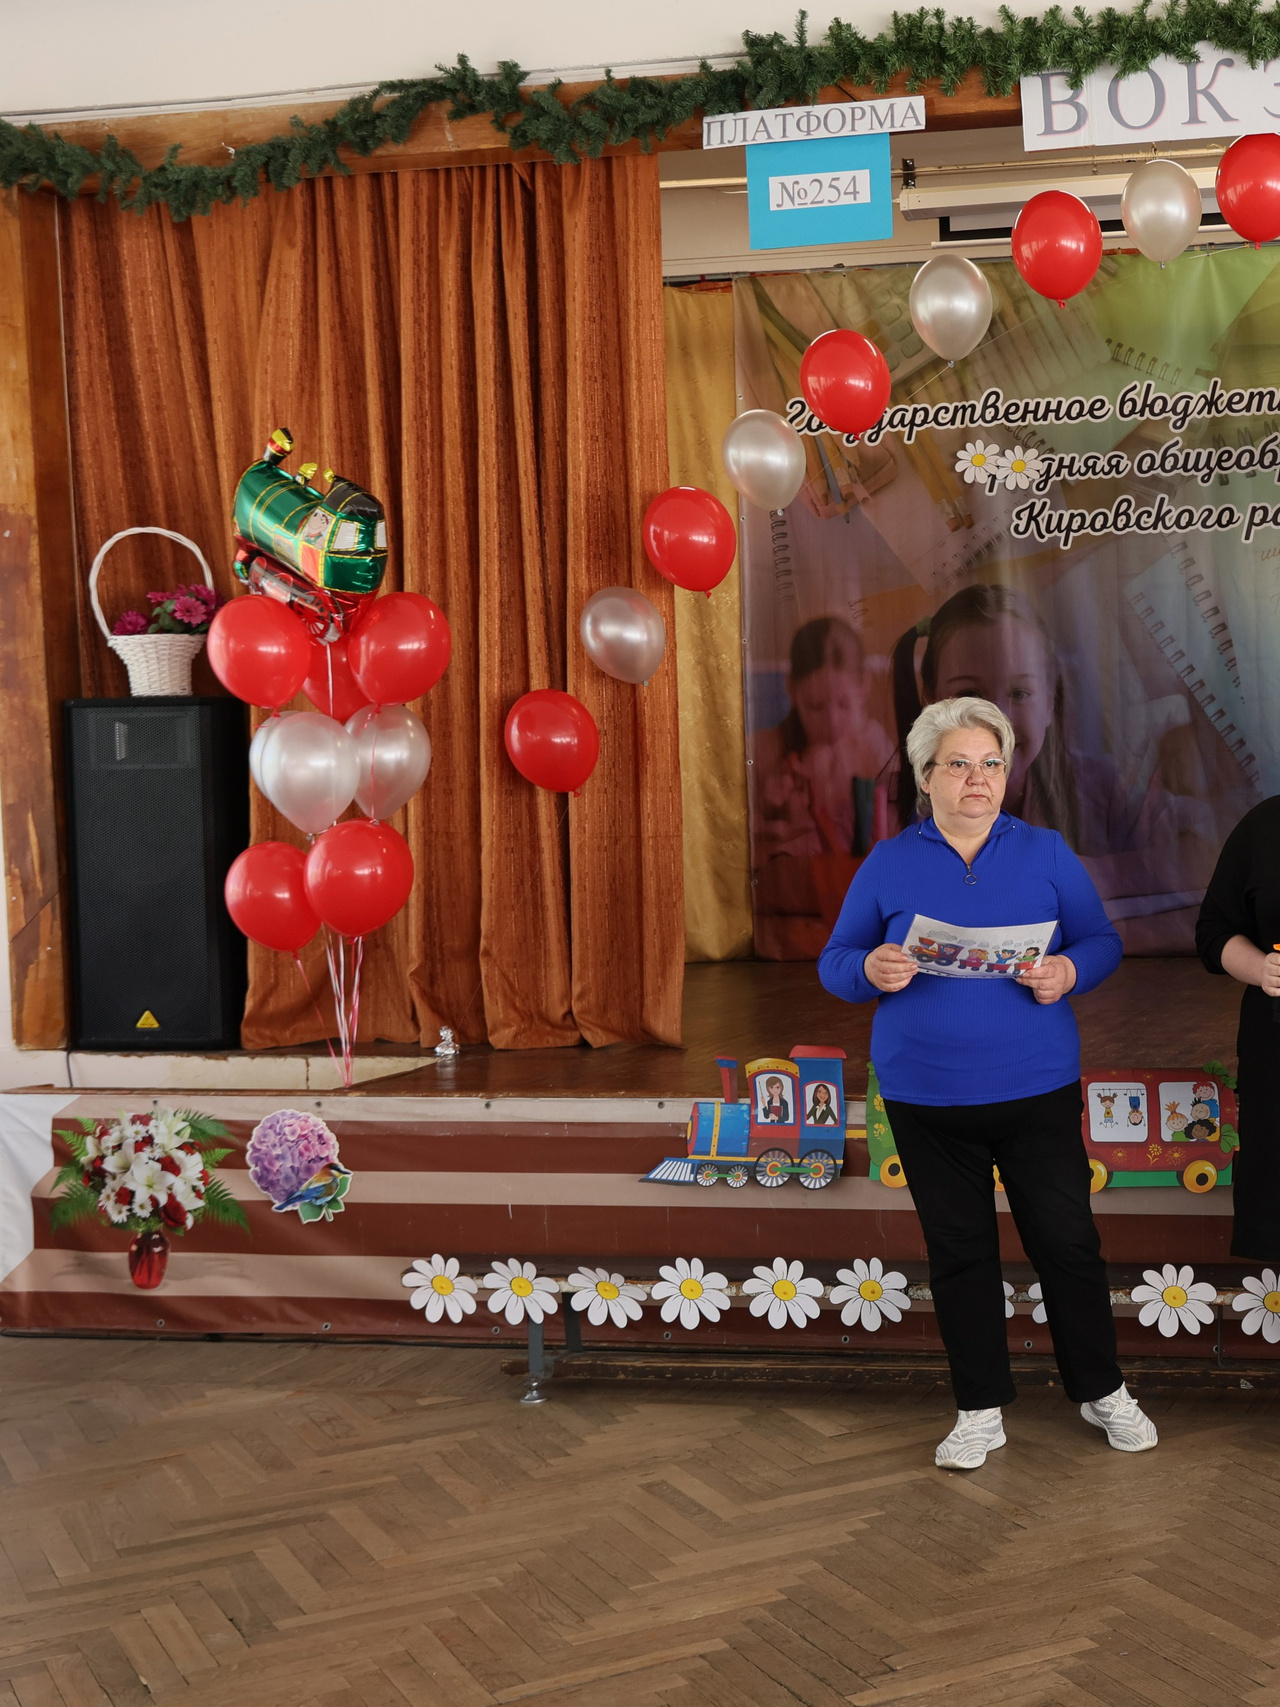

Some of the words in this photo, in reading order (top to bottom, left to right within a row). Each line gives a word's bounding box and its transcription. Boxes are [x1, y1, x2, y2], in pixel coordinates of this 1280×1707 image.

[704, 101, 922, 147] ПЛАТФОРМА
[776, 174, 860, 208] №254
[1012, 496, 1239, 547] Кировского
